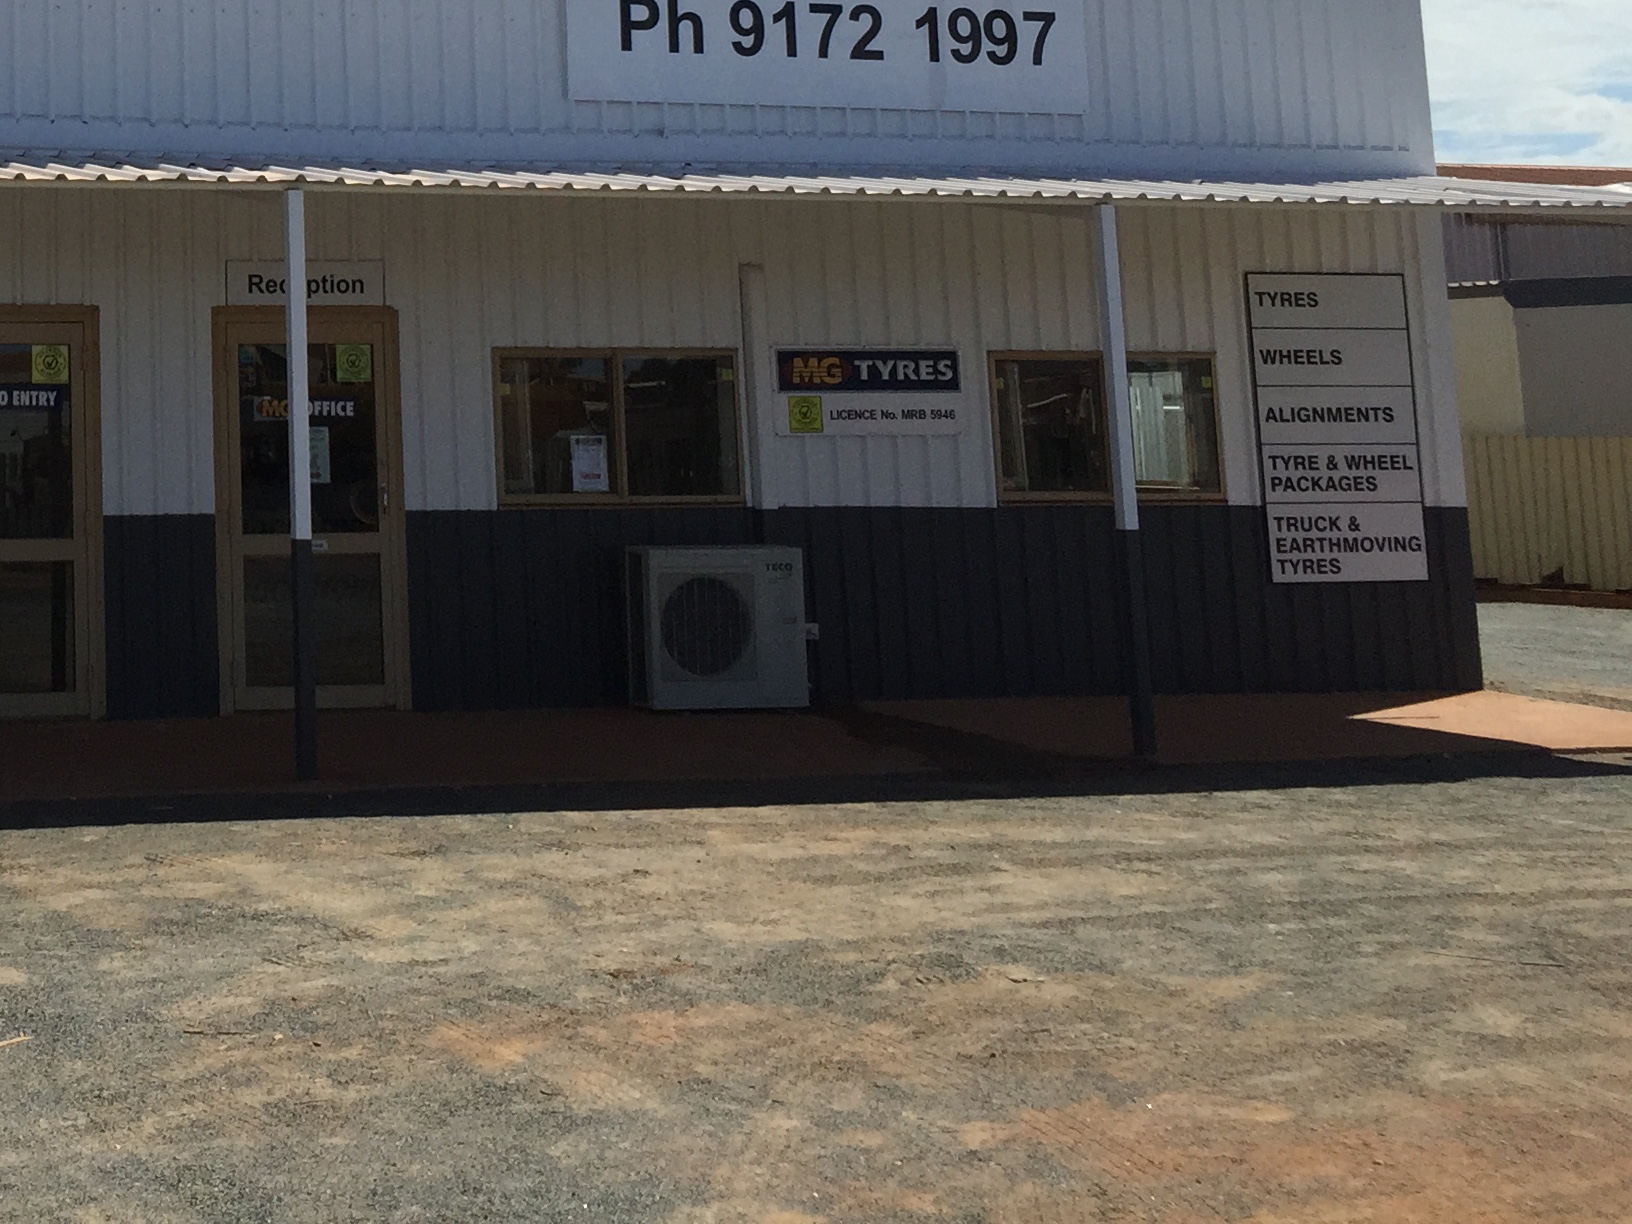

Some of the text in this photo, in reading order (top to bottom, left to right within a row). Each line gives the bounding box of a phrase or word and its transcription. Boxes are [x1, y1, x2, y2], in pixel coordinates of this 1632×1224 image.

[914, 5, 1057, 66] 1997
[248, 274, 365, 298] Recption
[1255, 292, 1319, 308] TYRES
[1259, 349, 1343, 365] WHEELS
[792, 356, 954, 384] MG TYRES
[12, 390, 58, 407] ENTRY
[830, 409, 877, 420] LICENCE
[880, 409, 898, 420] No.
[901, 409, 926, 420] MRB
[1265, 407, 1394, 423] ALIGNMENTS
[1268, 455, 1414, 471] TYRE & WHEEL
[1271, 476, 1378, 492] PACKAGES
[1273, 516, 1361, 532] TRUCK &
[1276, 536, 1422, 554] EARTHMOVING
[765, 562, 793, 572] TECO
[1277, 559, 1342, 574] TYRES
